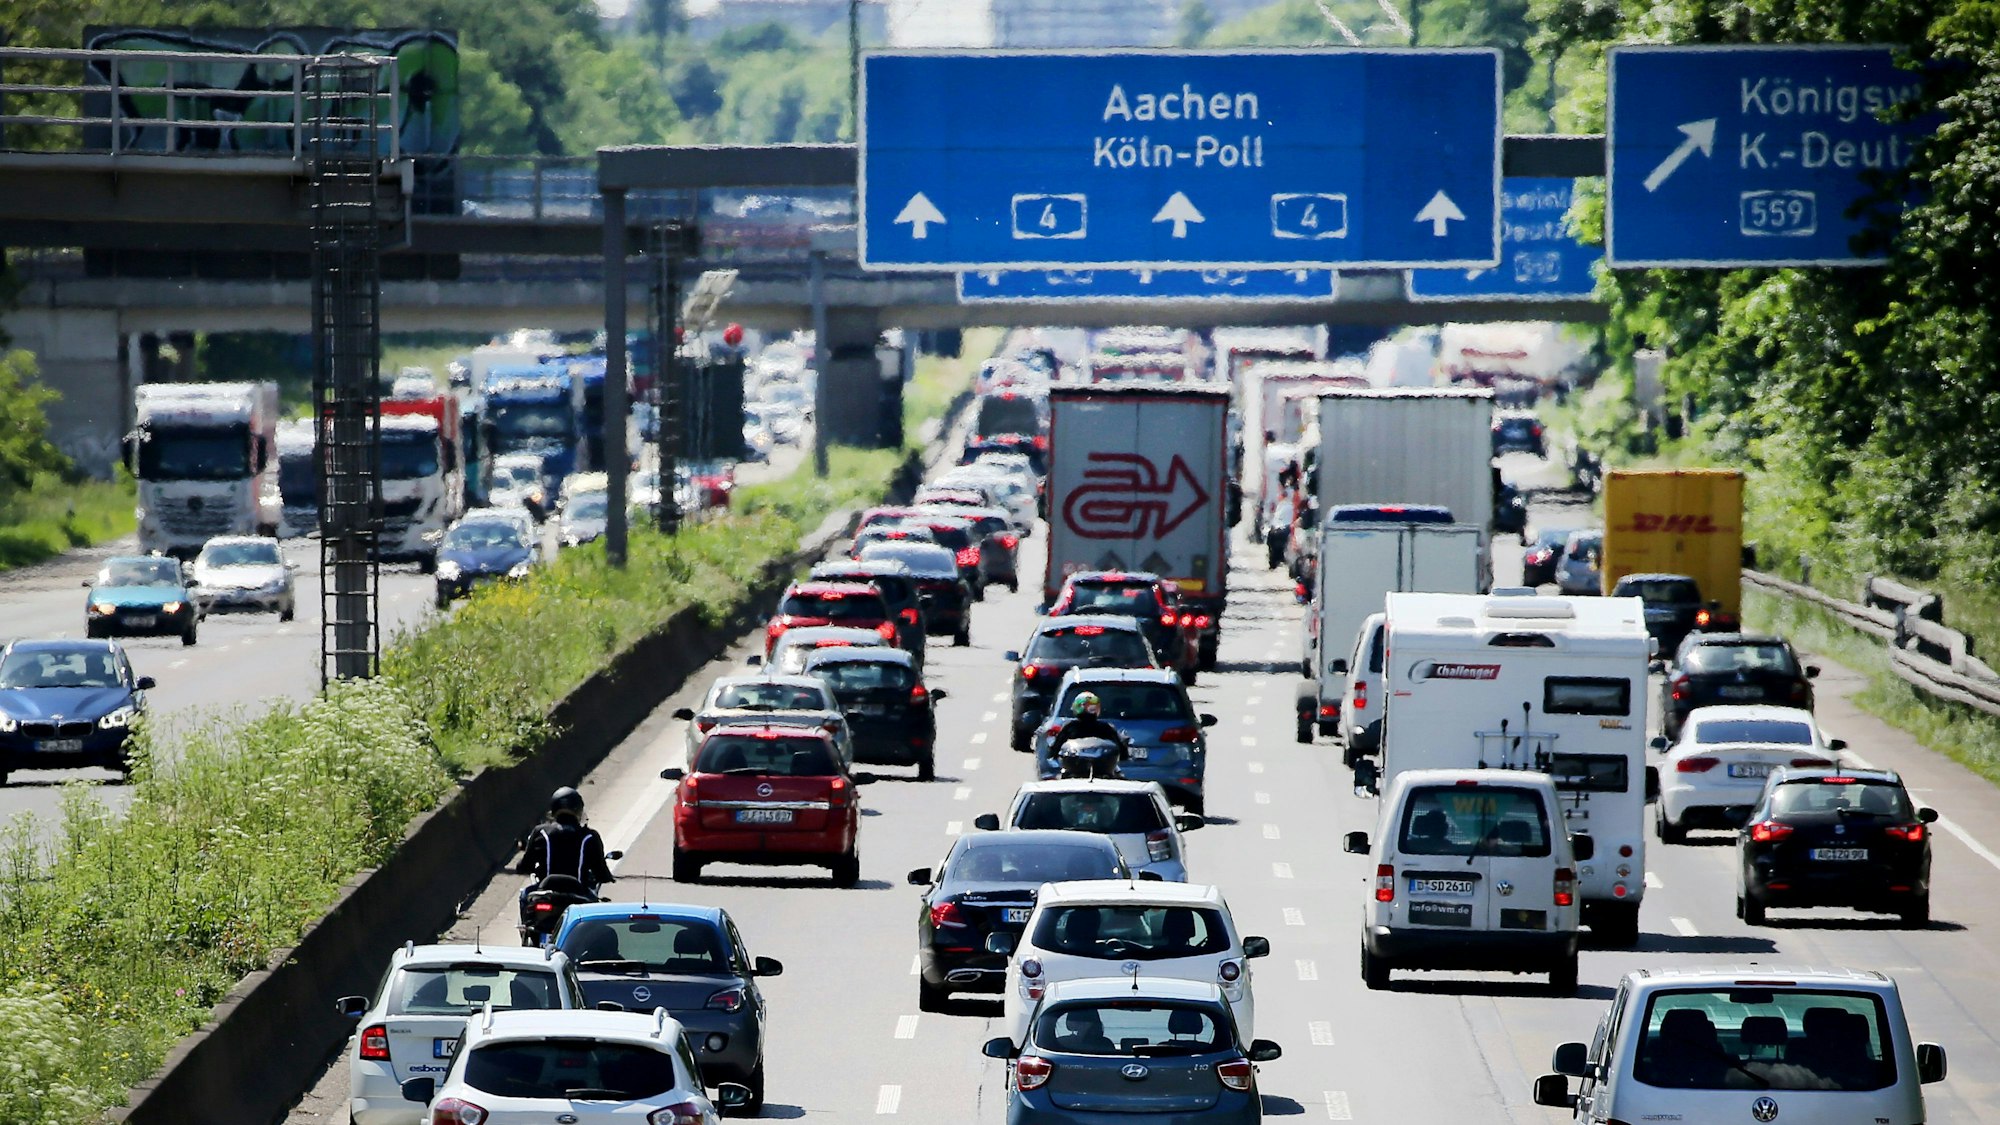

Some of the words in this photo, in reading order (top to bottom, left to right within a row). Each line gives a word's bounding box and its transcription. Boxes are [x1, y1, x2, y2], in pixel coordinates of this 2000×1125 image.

[1103, 83, 1259, 122] Aachen
[1093, 135, 1263, 168] Köln-Poll
[1039, 203, 1057, 229] 4
[1301, 203, 1319, 229] 4
[1752, 199, 1803, 227] 559
[1633, 513, 1718, 533] DHL
[1436, 665, 1496, 680] Challenger
[1411, 903, 1470, 914] info@wm.de
[446, 1041, 455, 1054] K
